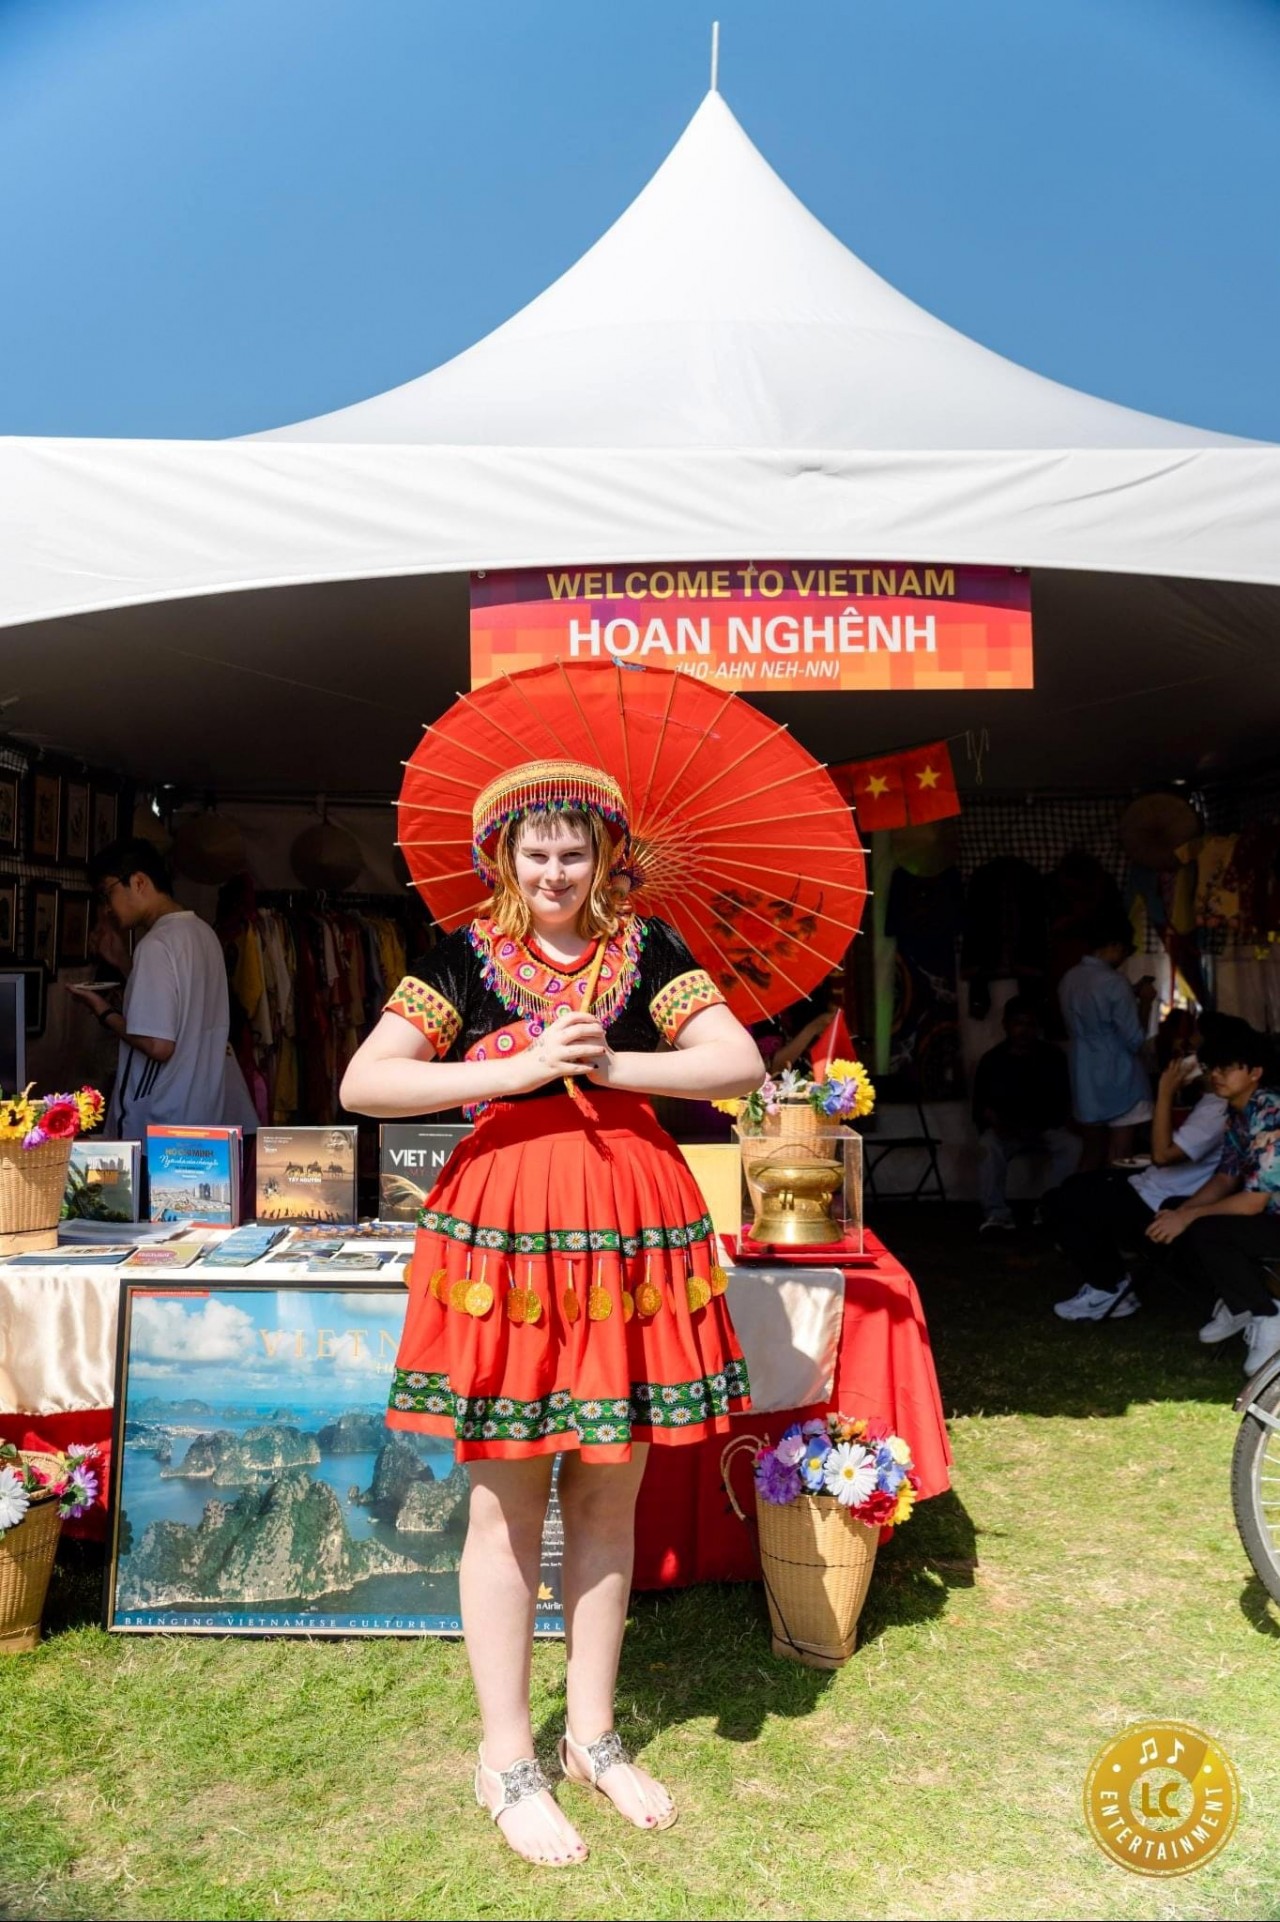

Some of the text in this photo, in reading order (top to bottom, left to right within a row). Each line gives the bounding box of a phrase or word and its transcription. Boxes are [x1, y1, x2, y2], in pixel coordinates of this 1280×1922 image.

[547, 569, 955, 600] WELCOME TO VIETNAM
[569, 606, 937, 656] HOAN NGHÊNH
[760, 660, 840, 680] NEH-NN)
[389, 1149, 446, 1167] VIET N
[259, 1328, 400, 1360] VIETN
[541, 1602, 564, 1611] Airlin
[124, 1617, 214, 1626] BRINGING
[228, 1617, 337, 1628] VIETNAMESE
[349, 1619, 427, 1629] CULTURE
[439, 1621, 460, 1630] TO
